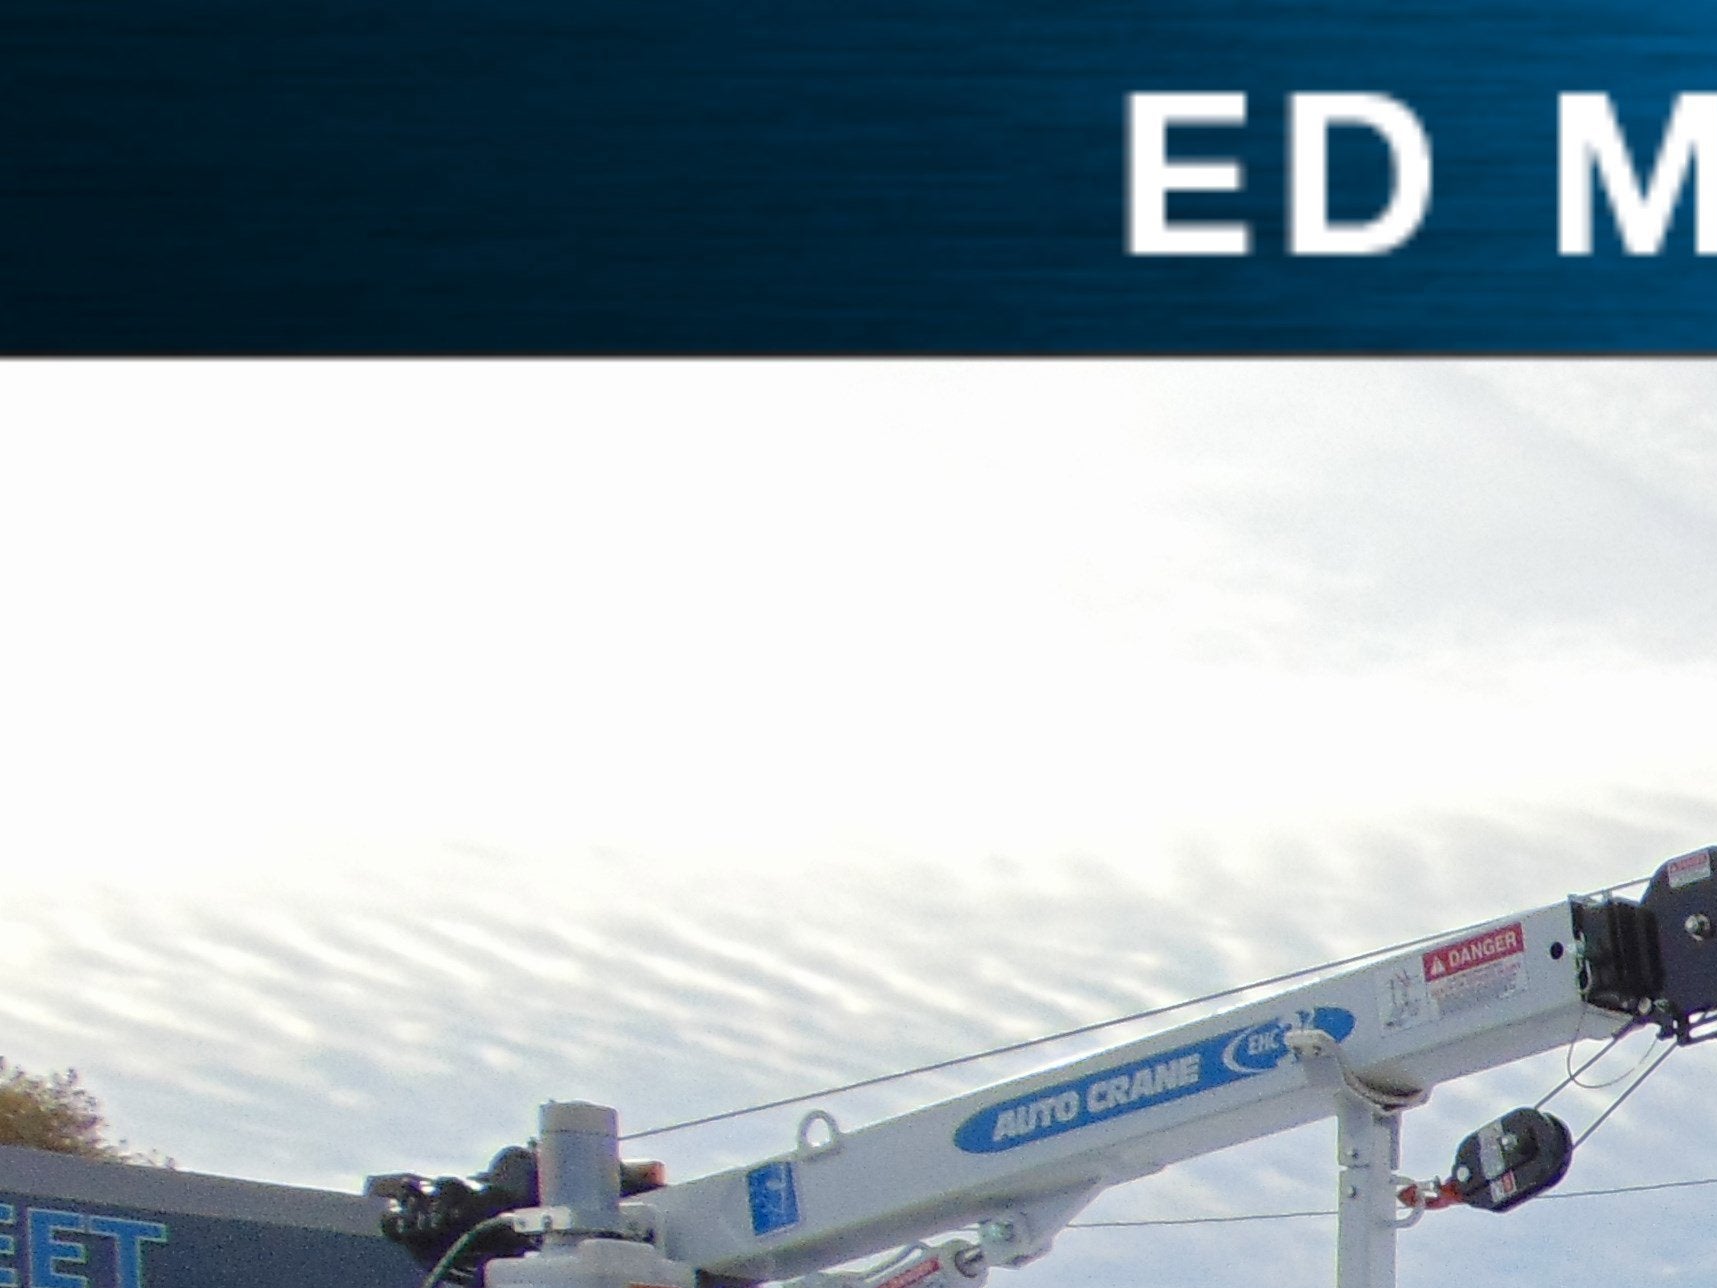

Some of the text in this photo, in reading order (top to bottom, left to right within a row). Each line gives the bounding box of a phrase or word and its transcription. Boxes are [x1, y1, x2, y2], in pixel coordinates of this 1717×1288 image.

[1449, 930, 1517, 967] DANGER
[993, 1054, 1199, 1142] AUTO CRANE
